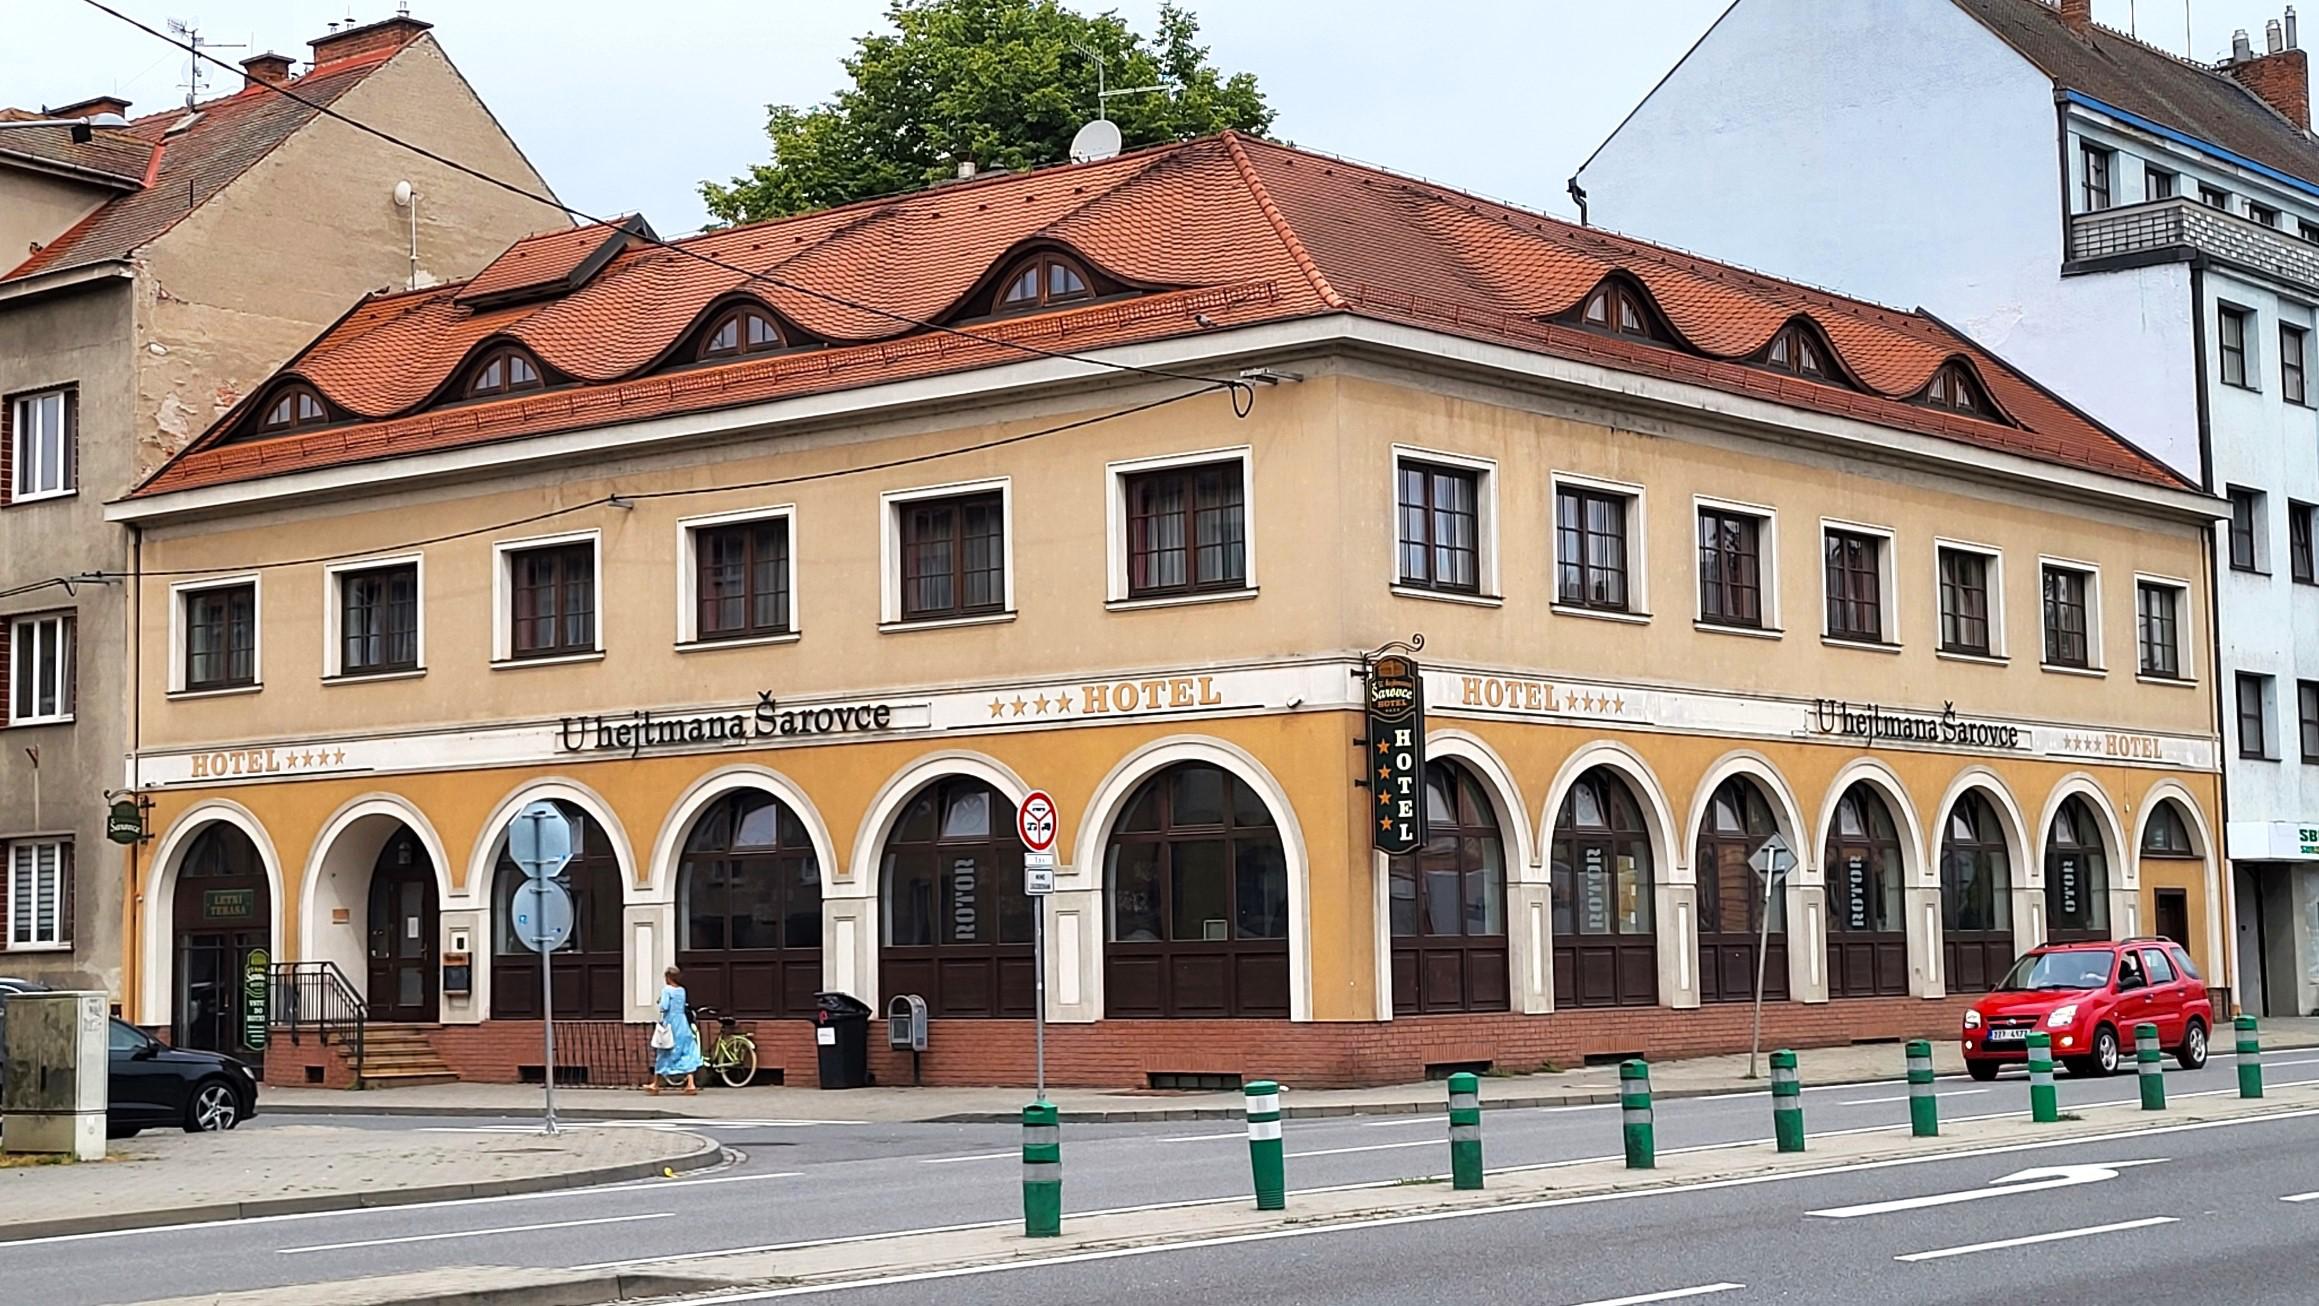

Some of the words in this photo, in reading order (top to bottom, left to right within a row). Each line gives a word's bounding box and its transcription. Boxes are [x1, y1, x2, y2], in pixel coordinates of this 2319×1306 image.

[1082, 676, 1222, 714] HOTEL
[1461, 676, 1560, 712] HOTEL
[559, 716, 588, 751] U
[594, 710, 747, 758] hejtmana
[755, 690, 890, 737] Šarovce
[1816, 699, 1836, 733] U
[1840, 703, 1939, 748] hejtmana
[1942, 700, 2018, 747] Šarovce
[2105, 734, 2162, 759] HOTEL
[191, 750, 280, 778] HOTEL
[1394, 729, 1413, 841] HOTEL
[2299, 829, 2319, 842] SB
[954, 858, 976, 940] ROTOR
[1586, 848, 1604, 929] ROTOR
[1849, 855, 1865, 927] ROTOR
